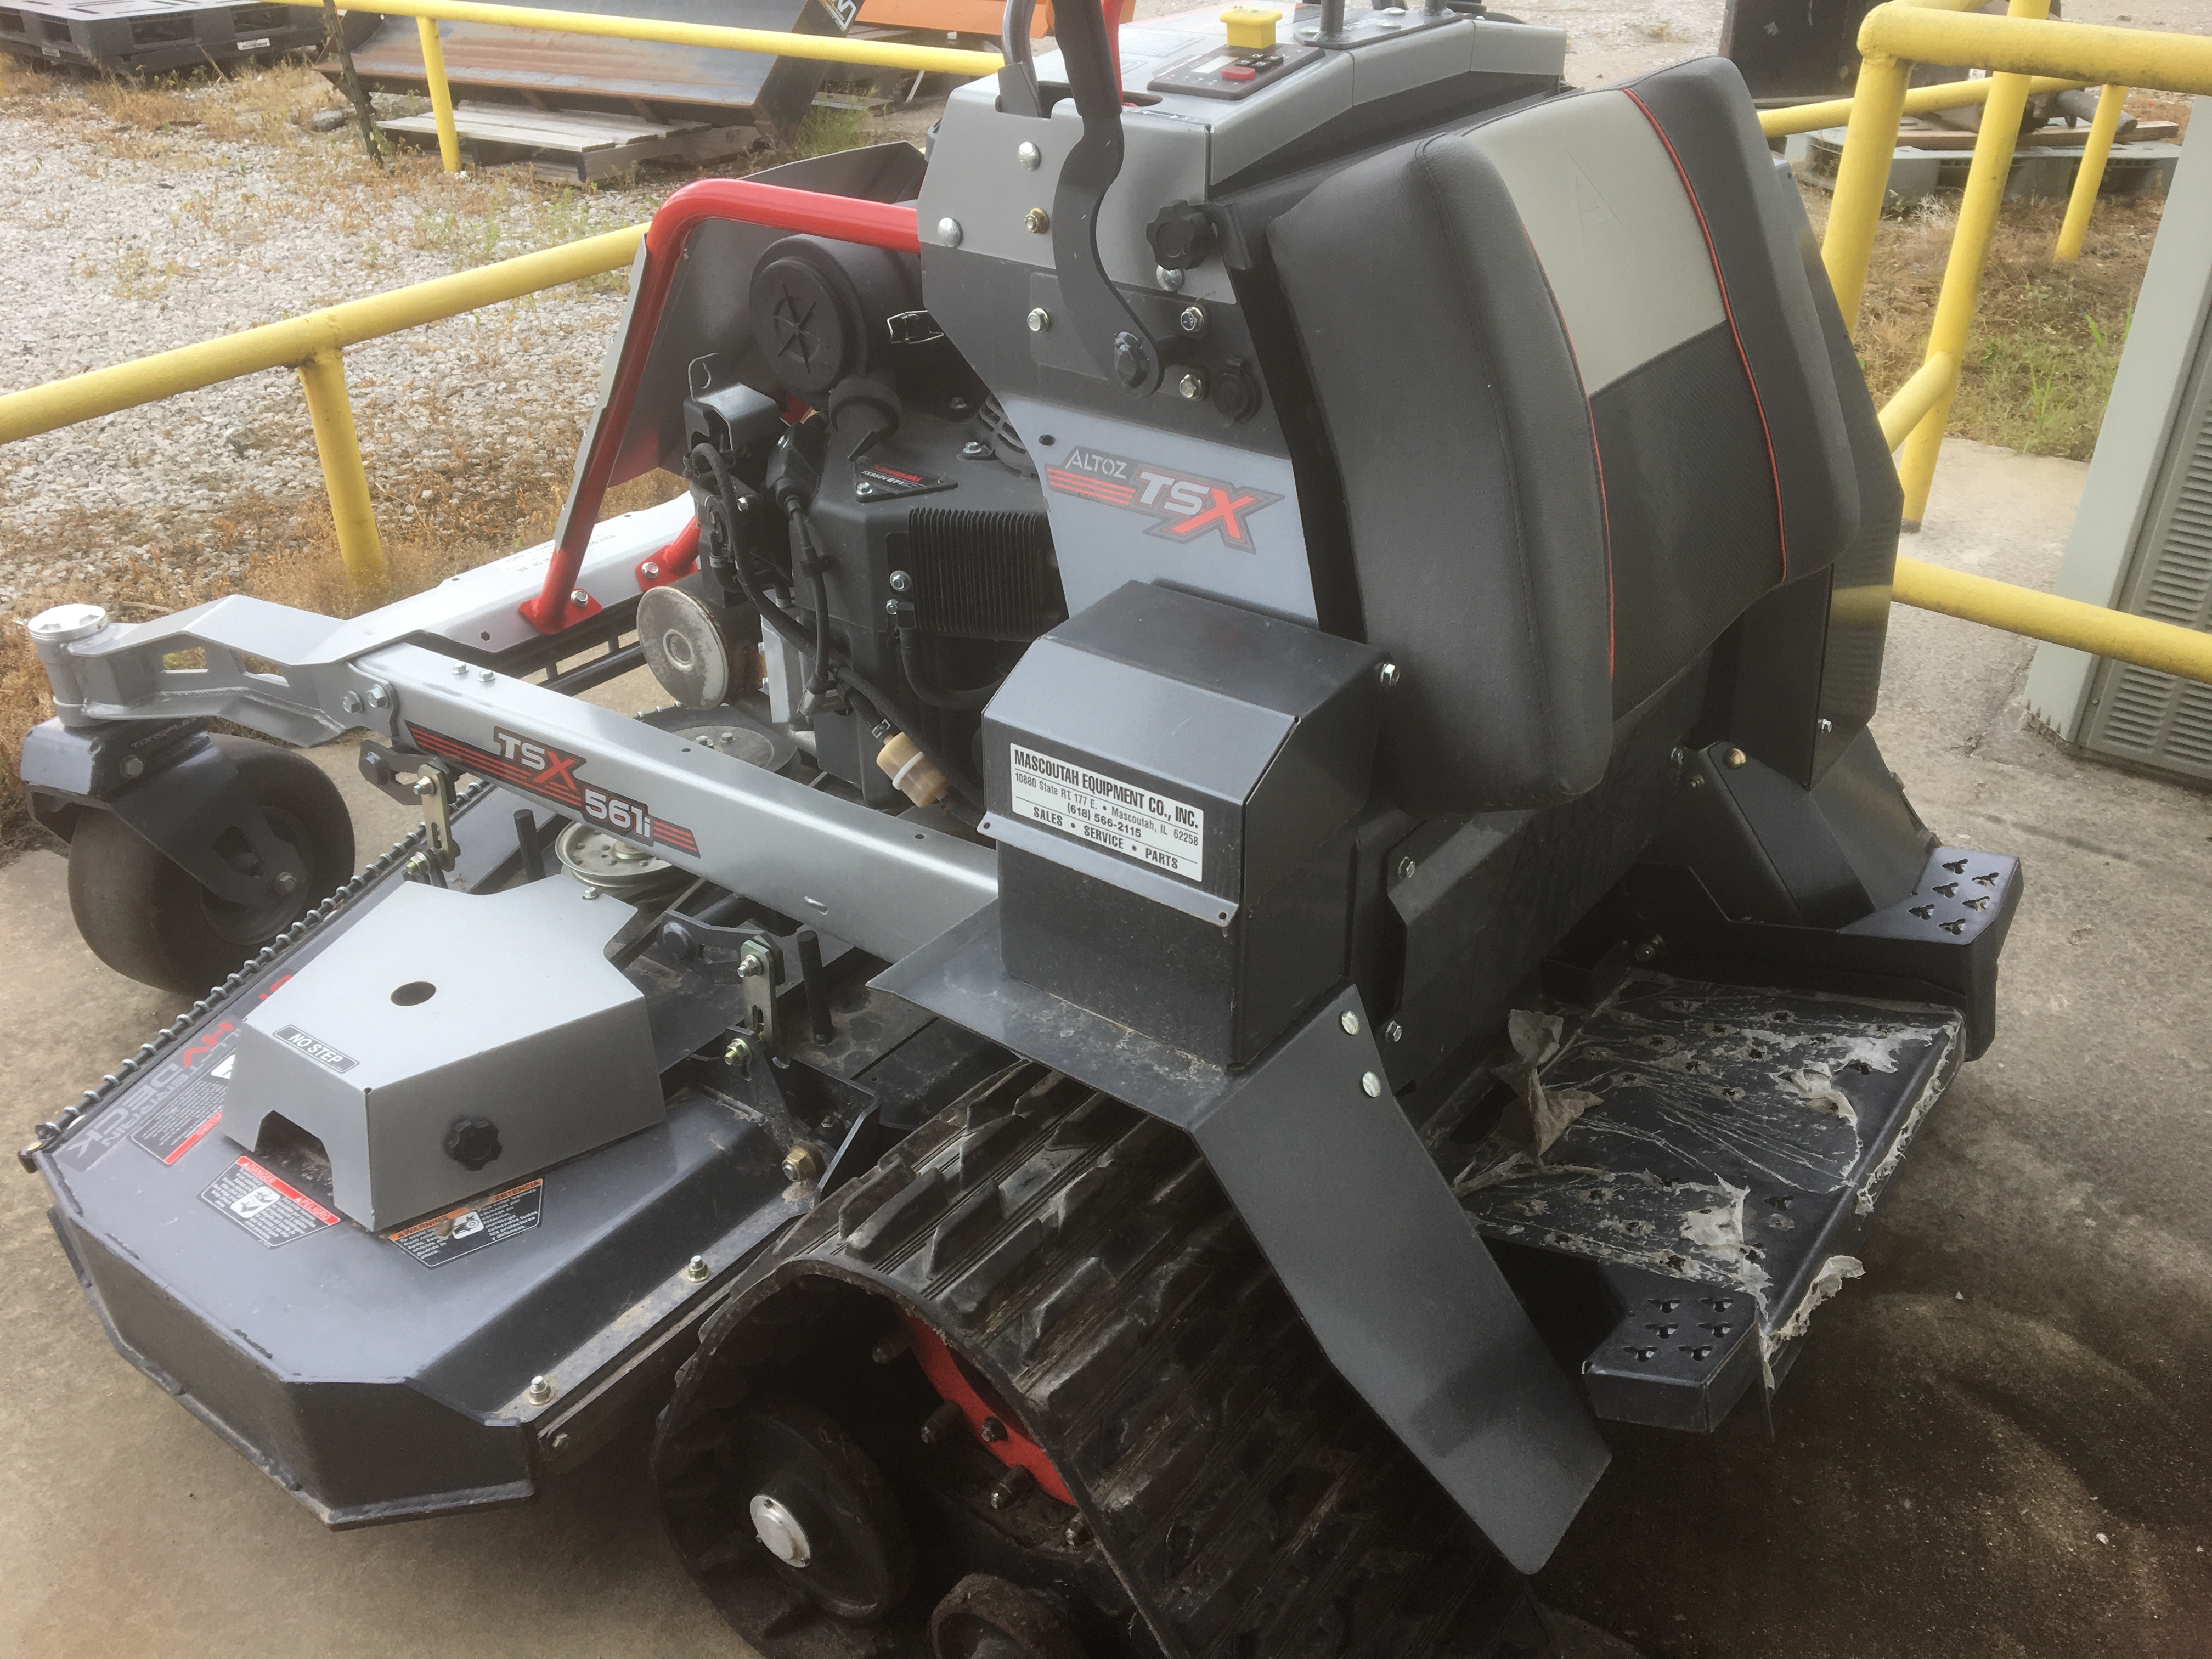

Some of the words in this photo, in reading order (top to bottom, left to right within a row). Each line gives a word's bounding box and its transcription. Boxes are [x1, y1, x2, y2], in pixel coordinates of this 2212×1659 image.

[1065, 449, 1127, 480] ALTOZ
[1138, 470, 1260, 540] TSX
[497, 732, 577, 791] TSX
[1014, 749, 1079, 786] MASCOUTAH
[1082, 772, 1145, 809] EQUIPMENT
[1148, 797, 1171, 822] CO.,
[1175, 805, 1198, 829] INC.
[584, 788, 651, 839] 561i
[1015, 772, 1036, 788] 10880
[1039, 780, 1058, 795] State
[1074, 793, 1087, 806] 177
[1111, 806, 1157, 833] Mascoutah,
[1160, 824, 1168, 836] IL
[1173, 828, 1198, 846] 62258
[1033, 806, 1063, 827] SALES
[1084, 825, 1124, 850] SERVICE
[1145, 848, 1178, 870] PARTS
[1067, 803, 1091, 820] (618)
[1094, 813, 1142, 838] 566-2115
[287, 1033, 312, 1047] NO
[307, 1043, 343, 1063] STEP
[67, 1063, 180, 1158] DECK
[101, 1028, 241, 1145] LL-TERRAIN
[247, 1164, 275, 1184] DANGER
[299, 1198, 331, 1221] PELIGRO
